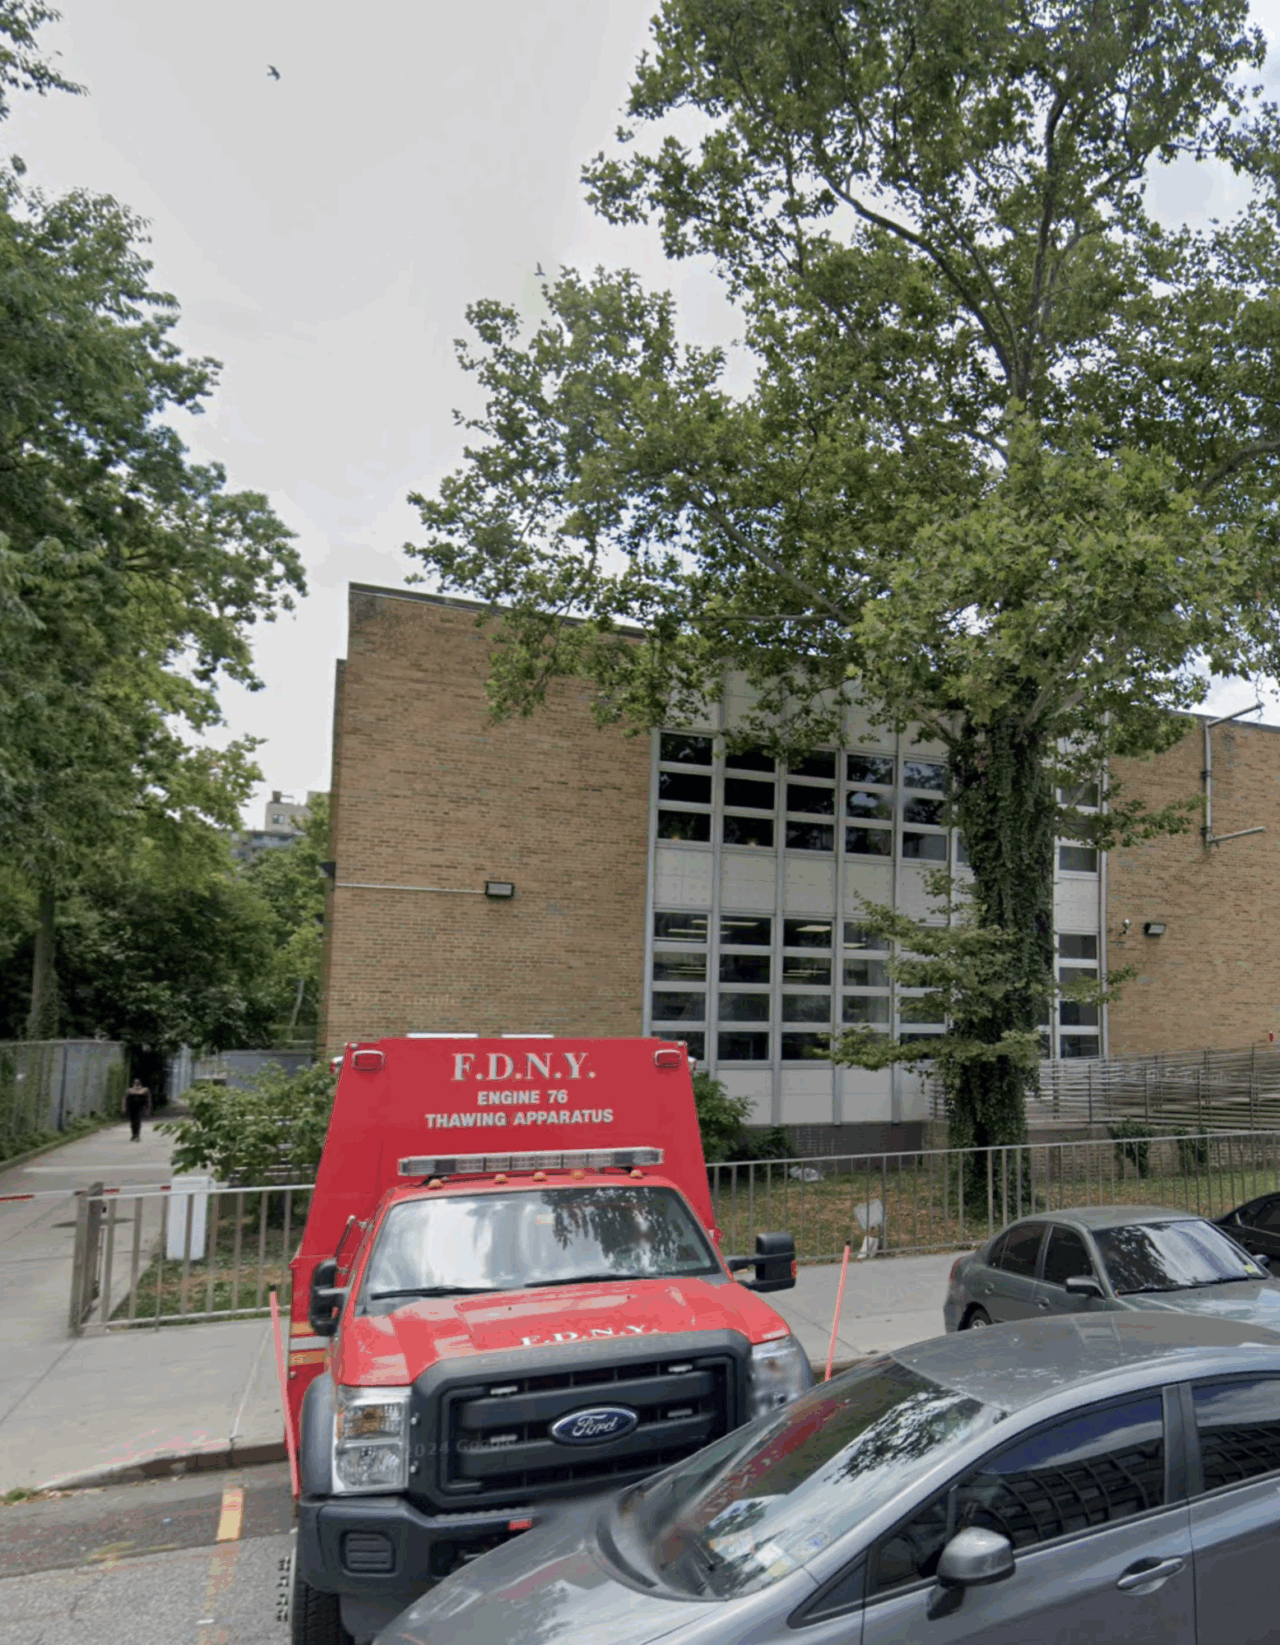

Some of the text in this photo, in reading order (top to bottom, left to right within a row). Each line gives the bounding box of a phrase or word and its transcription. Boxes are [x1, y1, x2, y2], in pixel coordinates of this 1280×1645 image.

[451, 1052, 596, 1081] F.D.N.Y.
[477, 1089, 568, 1106] ENGINE 76
[425, 1108, 614, 1129] THAWING APPARATUS
[571, 1412, 619, 1437] Ford
